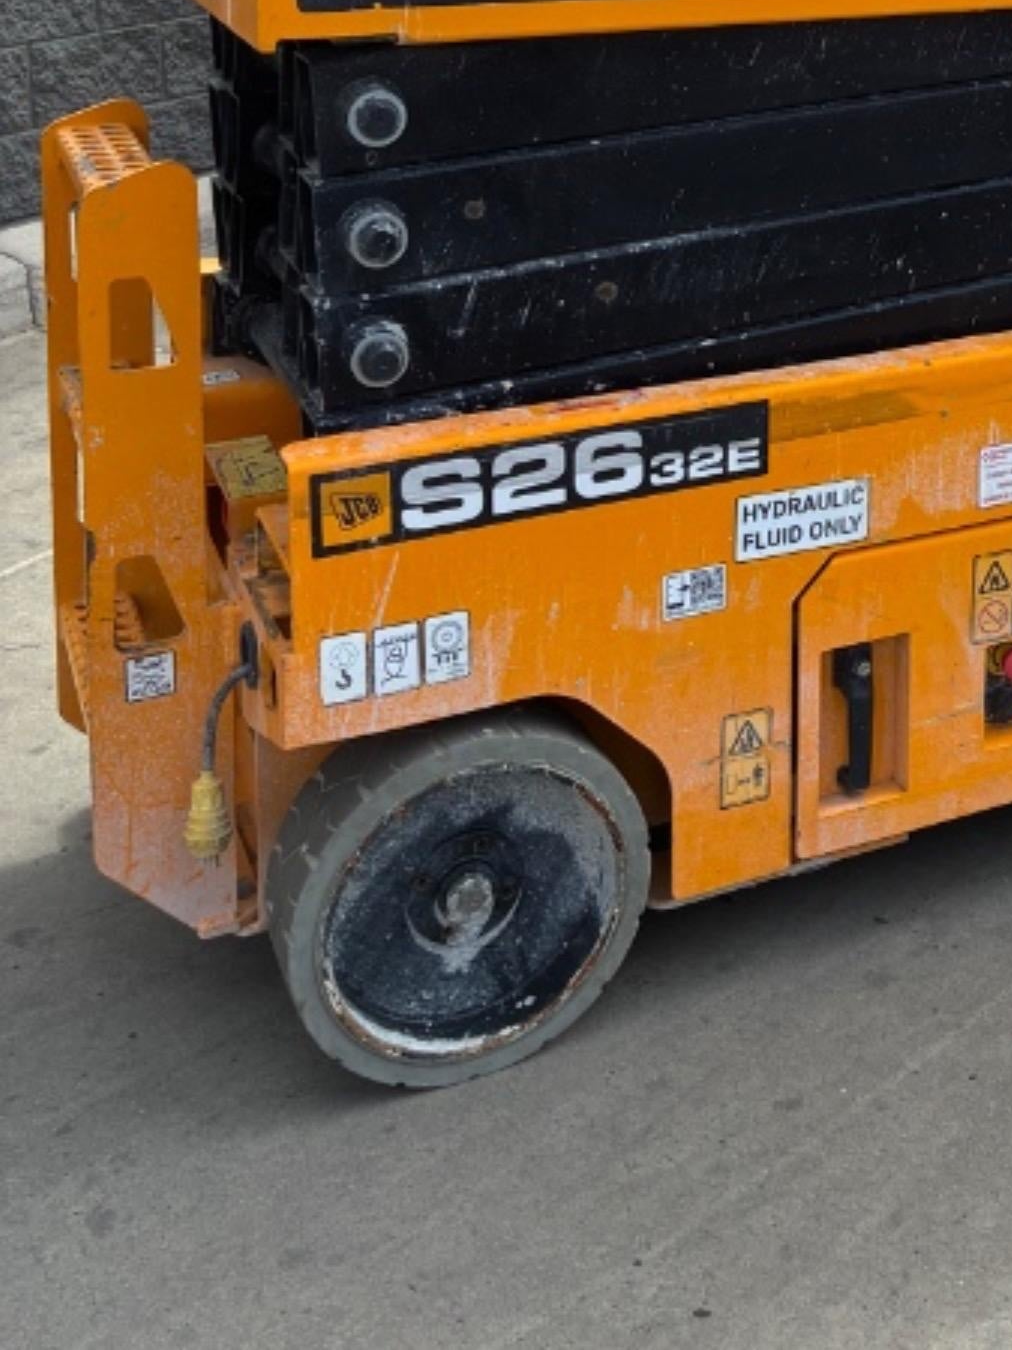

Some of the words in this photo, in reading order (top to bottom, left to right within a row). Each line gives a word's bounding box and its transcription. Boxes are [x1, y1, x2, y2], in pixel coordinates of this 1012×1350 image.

[338, 492, 381, 526] JCB
[743, 485, 864, 524] HYDRAULIC
[743, 524, 803, 552] FLUID
[808, 513, 863, 541] ONLY
